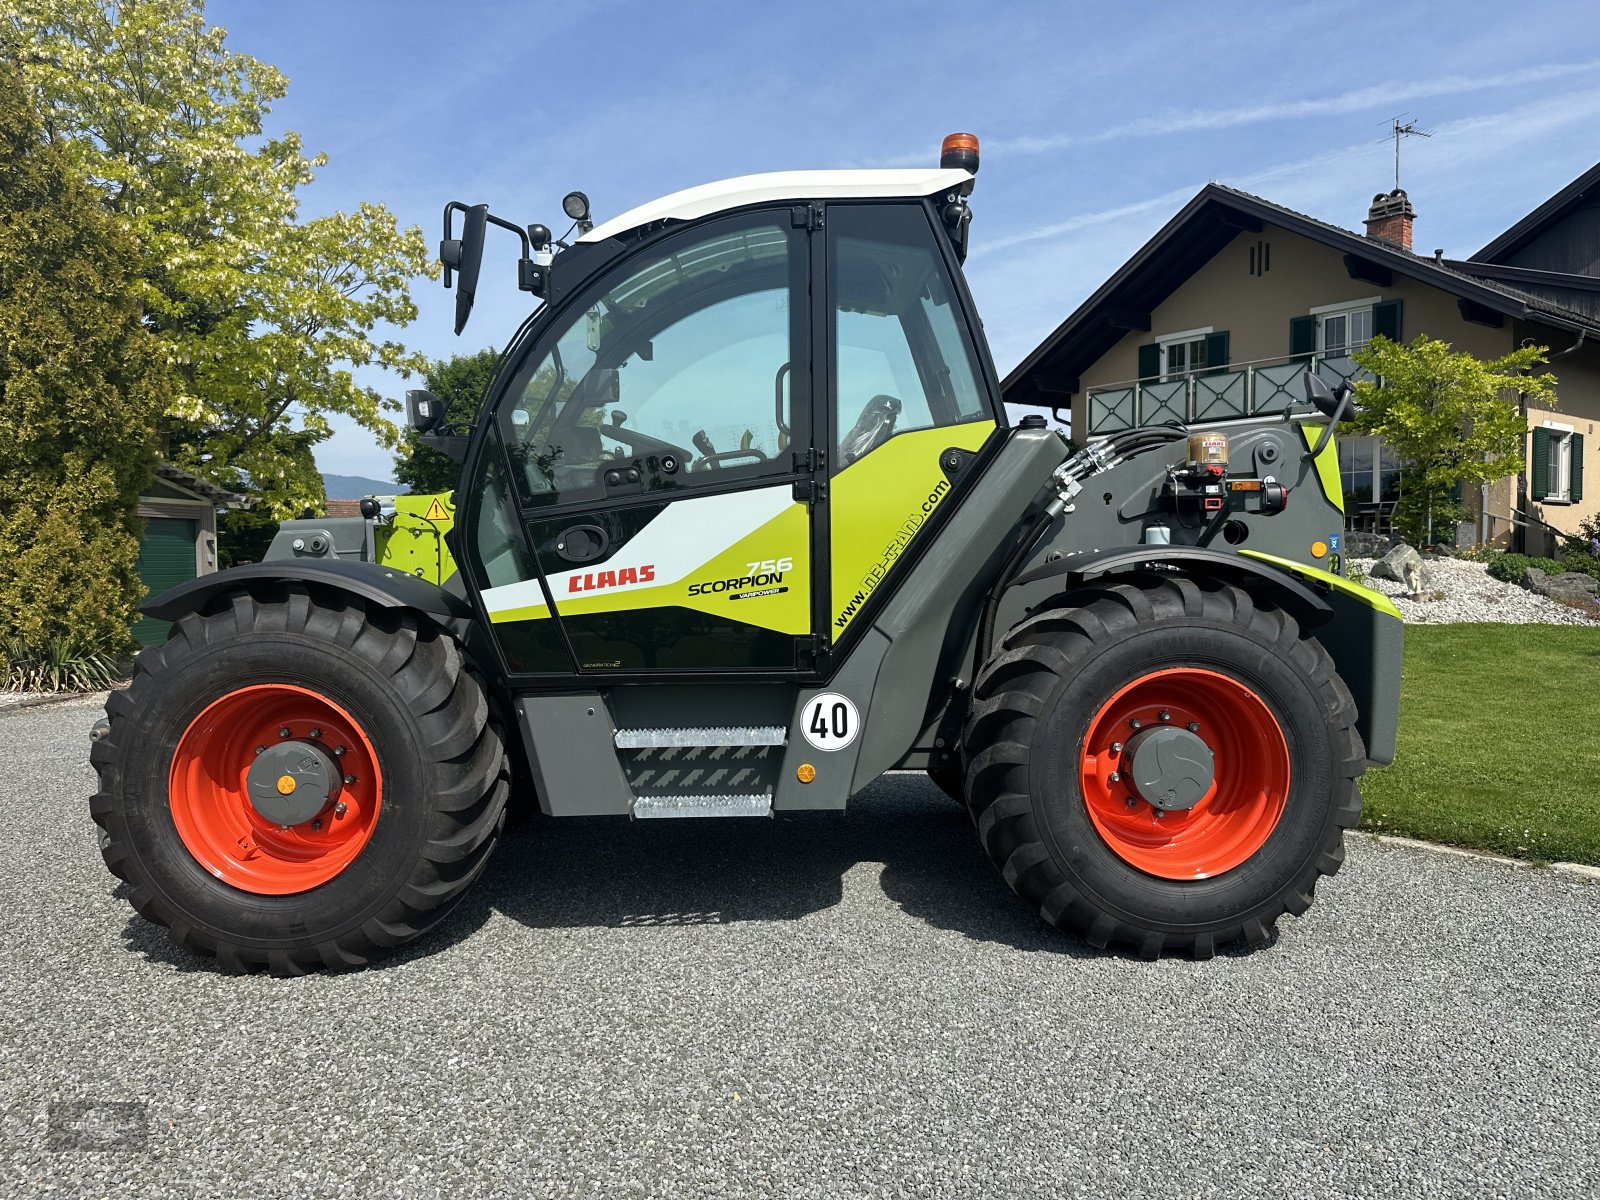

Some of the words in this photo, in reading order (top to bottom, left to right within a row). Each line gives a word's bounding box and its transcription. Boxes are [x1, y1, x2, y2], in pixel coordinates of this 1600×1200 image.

[568, 564, 655, 593] CLAAS
[746, 557, 793, 578] 756
[688, 571, 783, 597] SCORPION
[739, 588, 780, 599] VARIPOWER
[810, 702, 848, 739] 40
